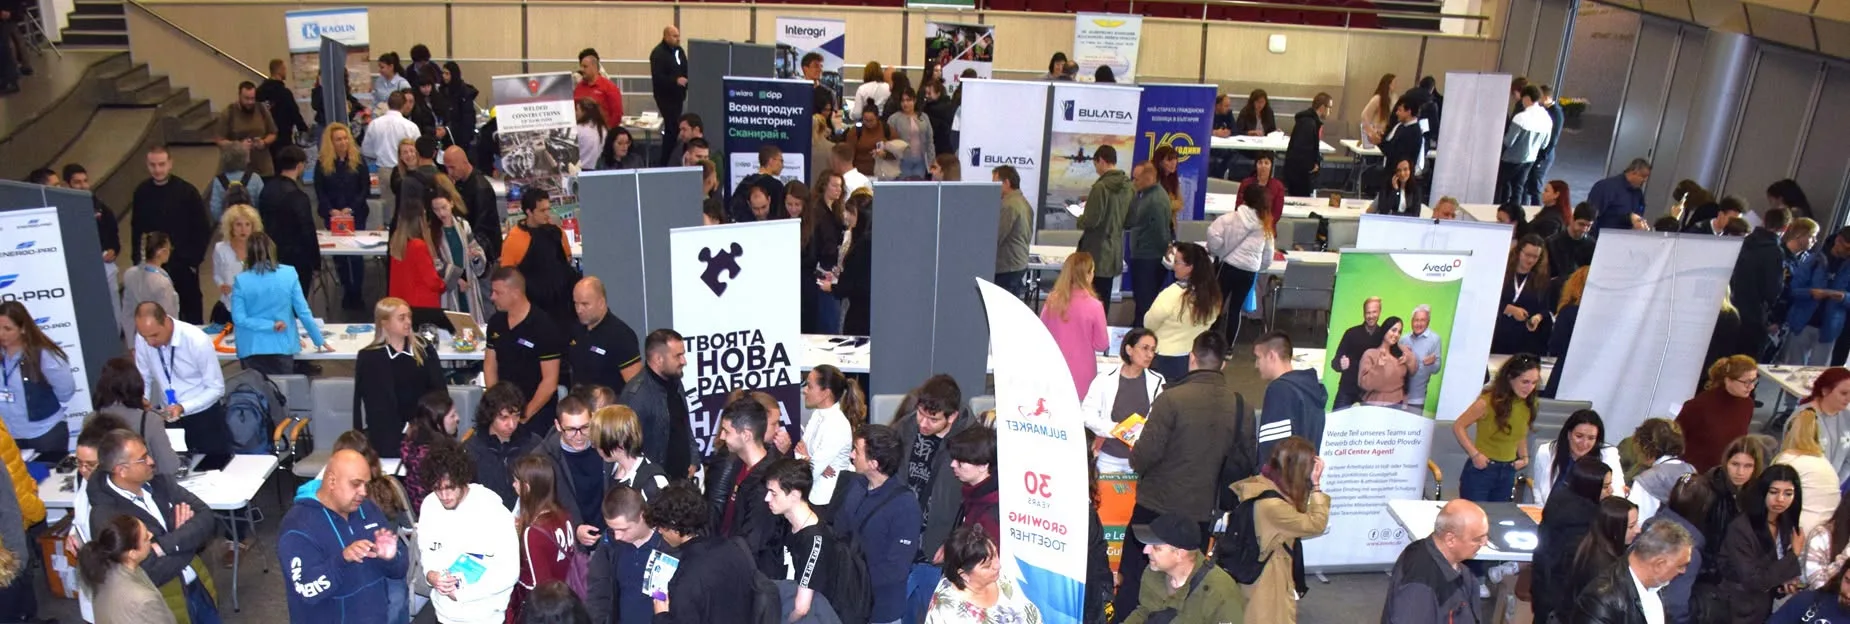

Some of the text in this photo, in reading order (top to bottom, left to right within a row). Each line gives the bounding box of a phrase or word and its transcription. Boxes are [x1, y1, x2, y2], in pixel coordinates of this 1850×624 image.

[321, 24, 356, 33] KAOLIN
[785, 24, 826, 38] Interagri
[728, 102, 804, 117] Всеки продукт
[1078, 108, 1133, 120] BULATSA
[728, 115, 796, 129] има история.
[728, 128, 779, 140] Сканирай
[984, 155, 1034, 165] BULATSA
[1422, 263, 1453, 272] Avedo
[0, 288, 65, 303] O-PRO
[682, 329, 765, 352] ТВОЯТА
[697, 342, 791, 377] НОВА
[698, 367, 792, 396] РАБОТА
[1371, 448, 1395, 456] Agent!
